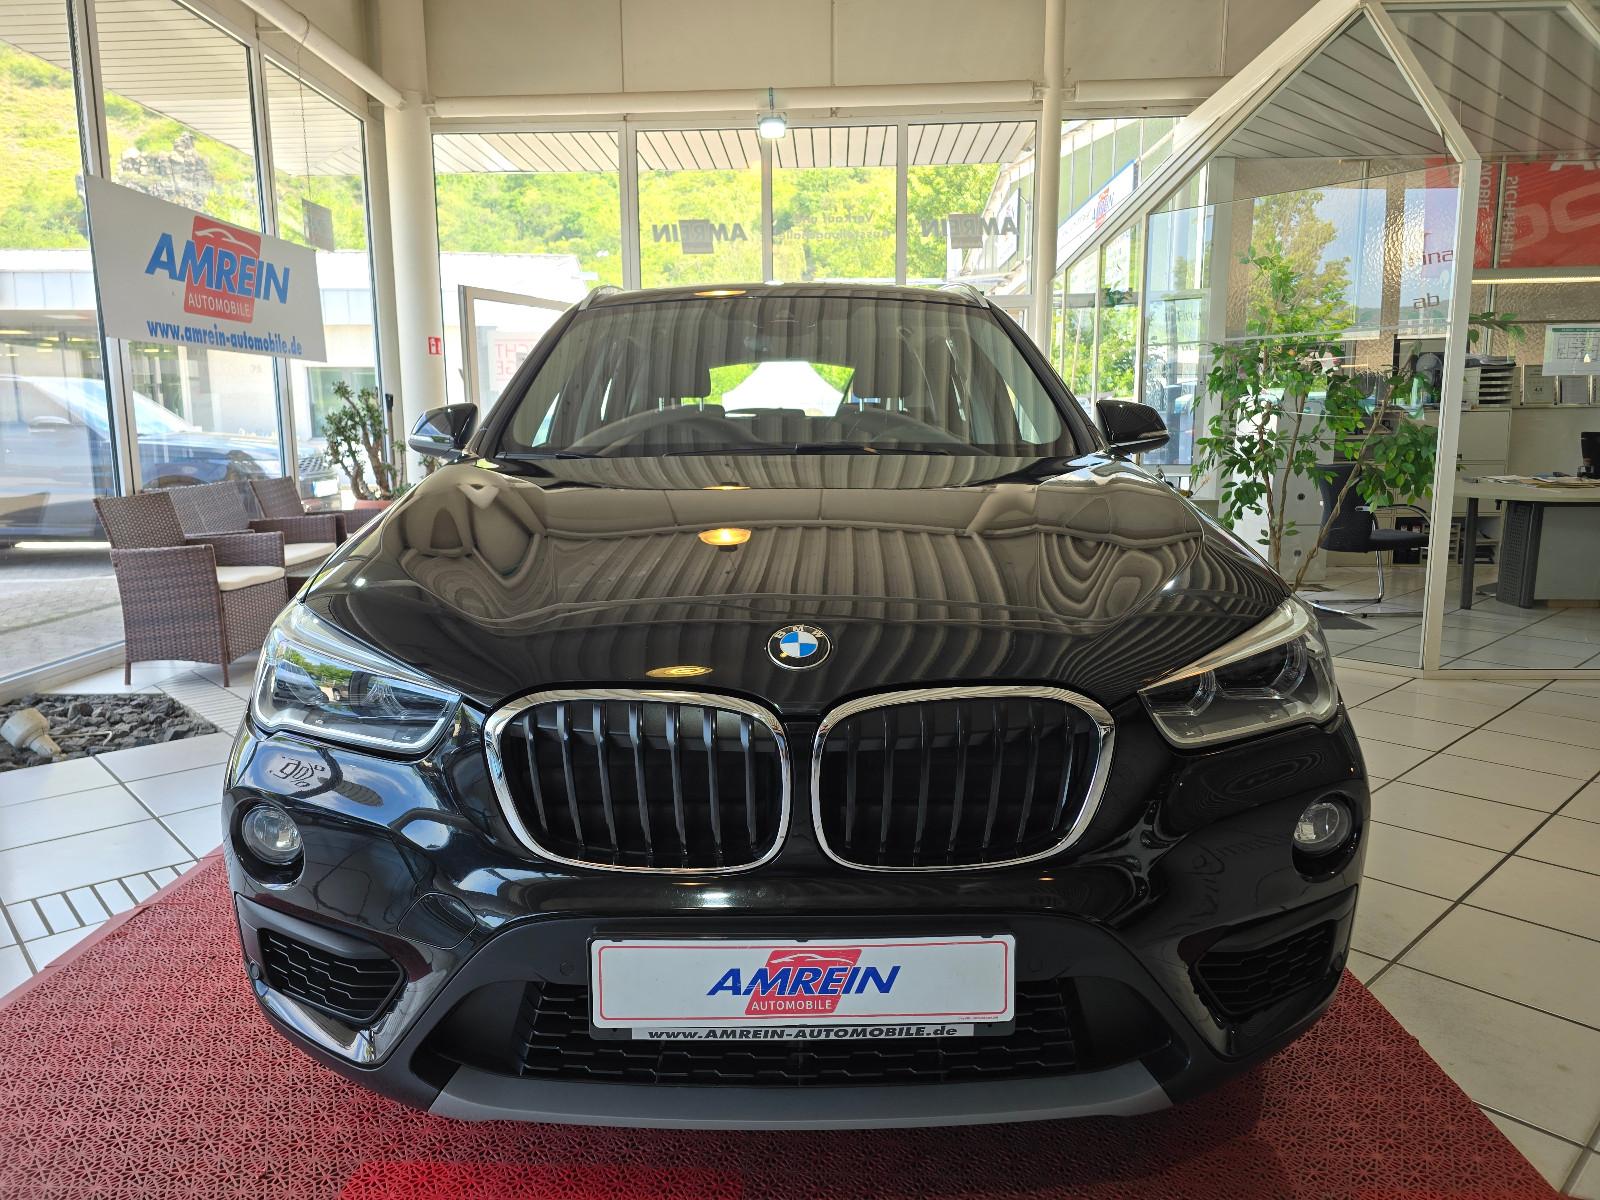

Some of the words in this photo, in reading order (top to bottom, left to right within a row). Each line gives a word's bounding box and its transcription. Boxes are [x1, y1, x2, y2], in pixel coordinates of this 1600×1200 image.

[144, 232, 290, 304] AMREIN
[188, 294, 251, 318] AUTOMOBILE
[147, 320, 303, 356] www.amrein-automobile.de
[773, 624, 824, 639] BMW
[706, 965, 901, 996] AMREIN
[751, 999, 832, 1012] AUTOMOBILE
[647, 1026, 958, 1040] www.AMREIN-AUTOMOBILE.de
